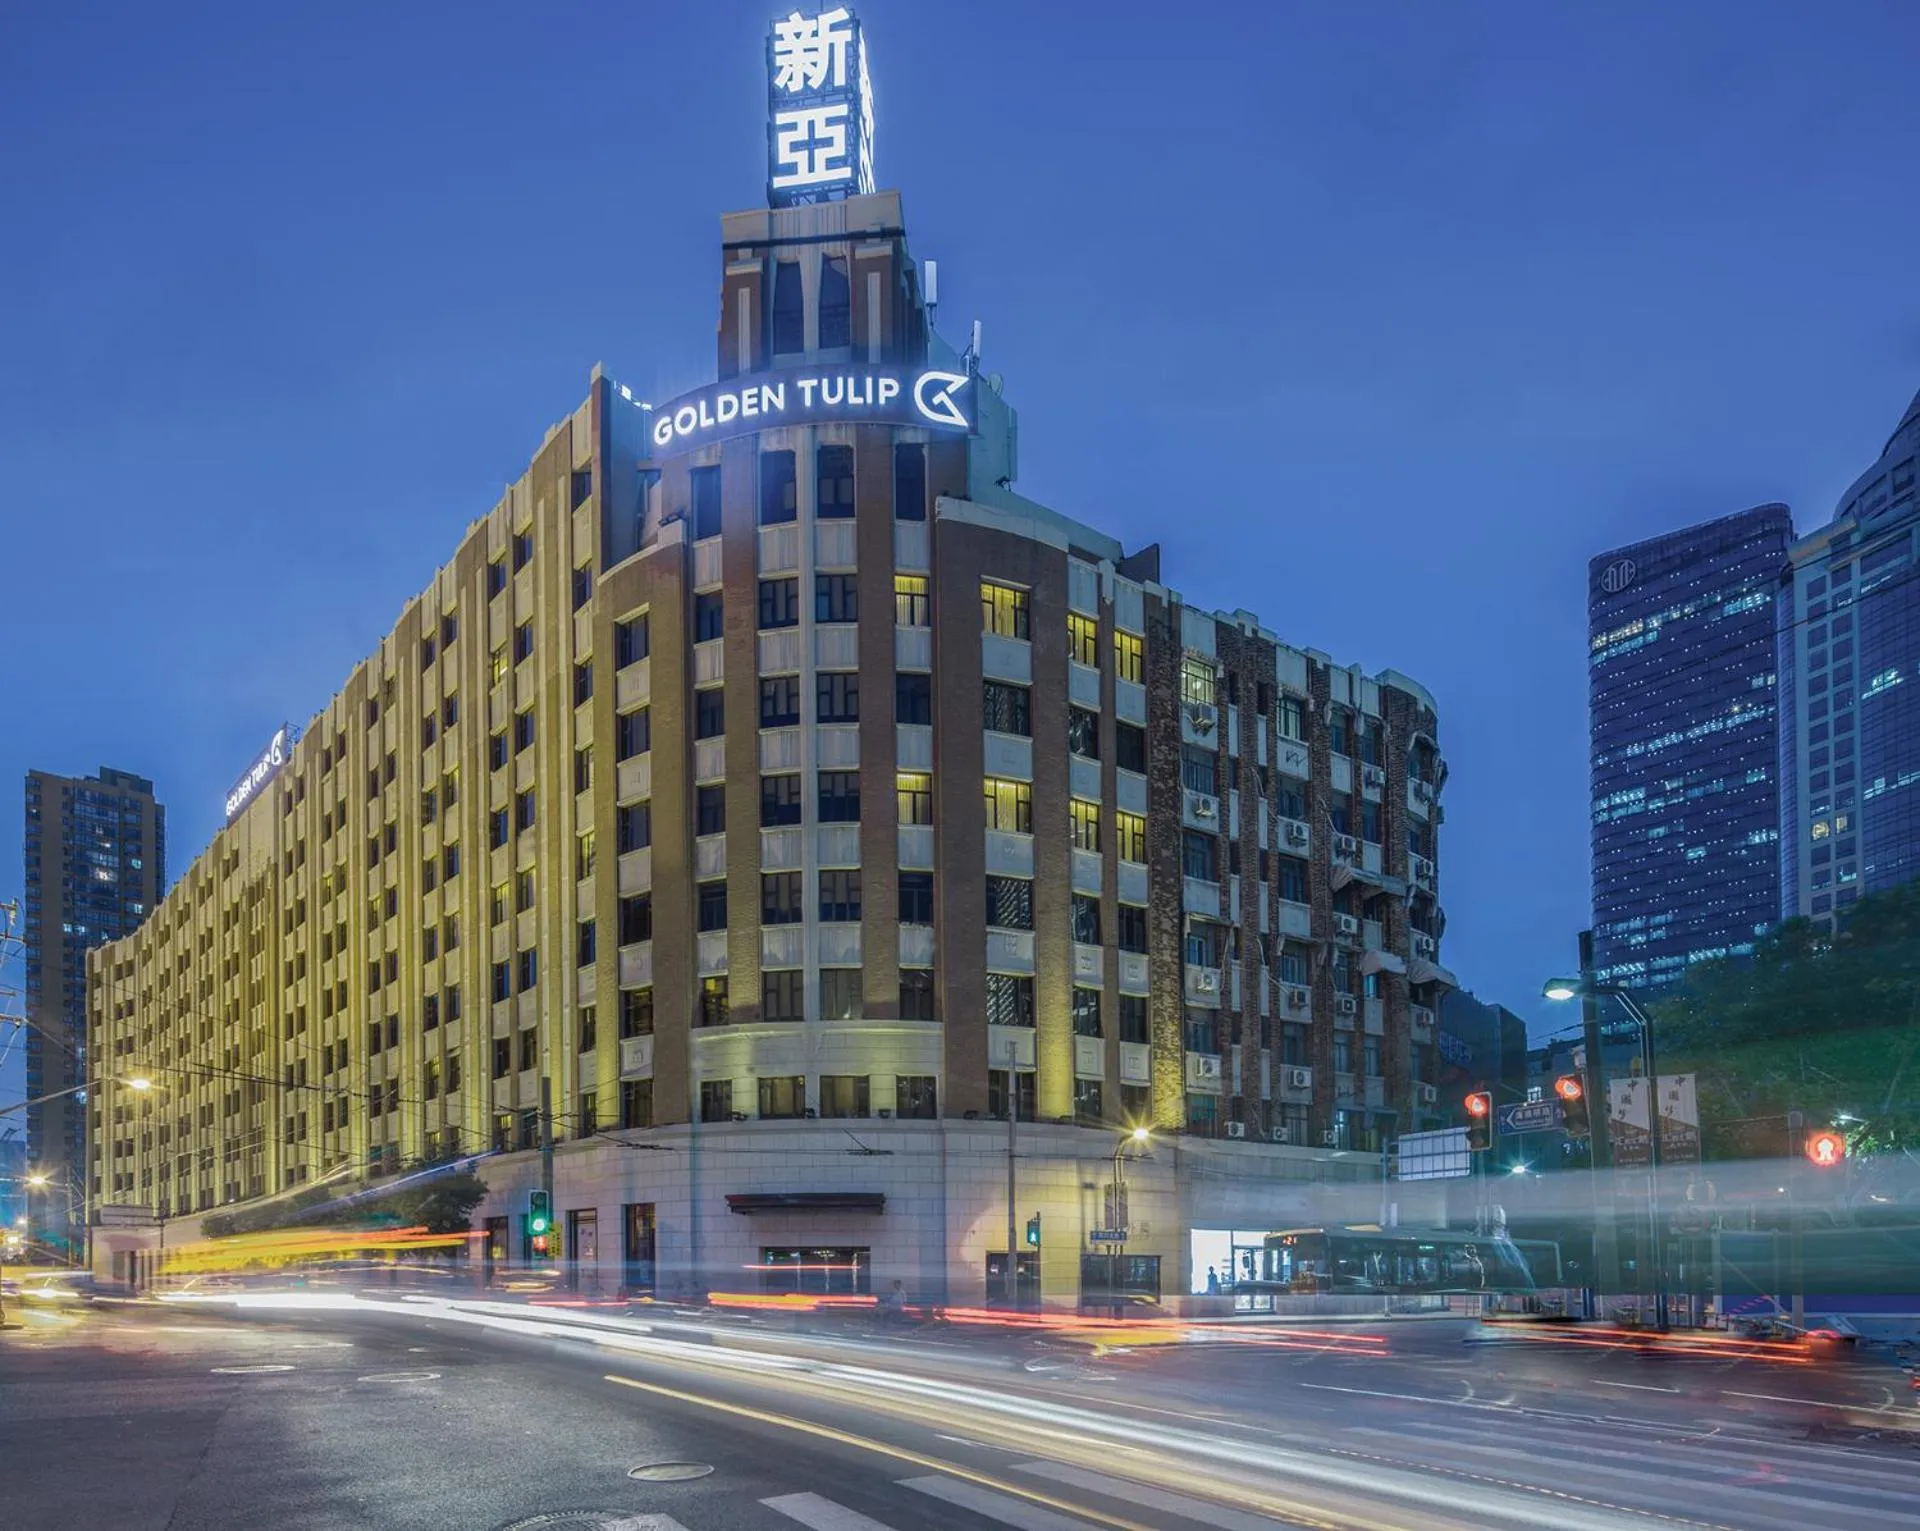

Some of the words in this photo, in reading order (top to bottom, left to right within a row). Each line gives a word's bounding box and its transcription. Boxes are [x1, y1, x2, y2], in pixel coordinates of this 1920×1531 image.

[774, 8, 852, 188] 新亞
[653, 383, 784, 445] GOLDEN
[798, 377, 899, 407] TULIP
